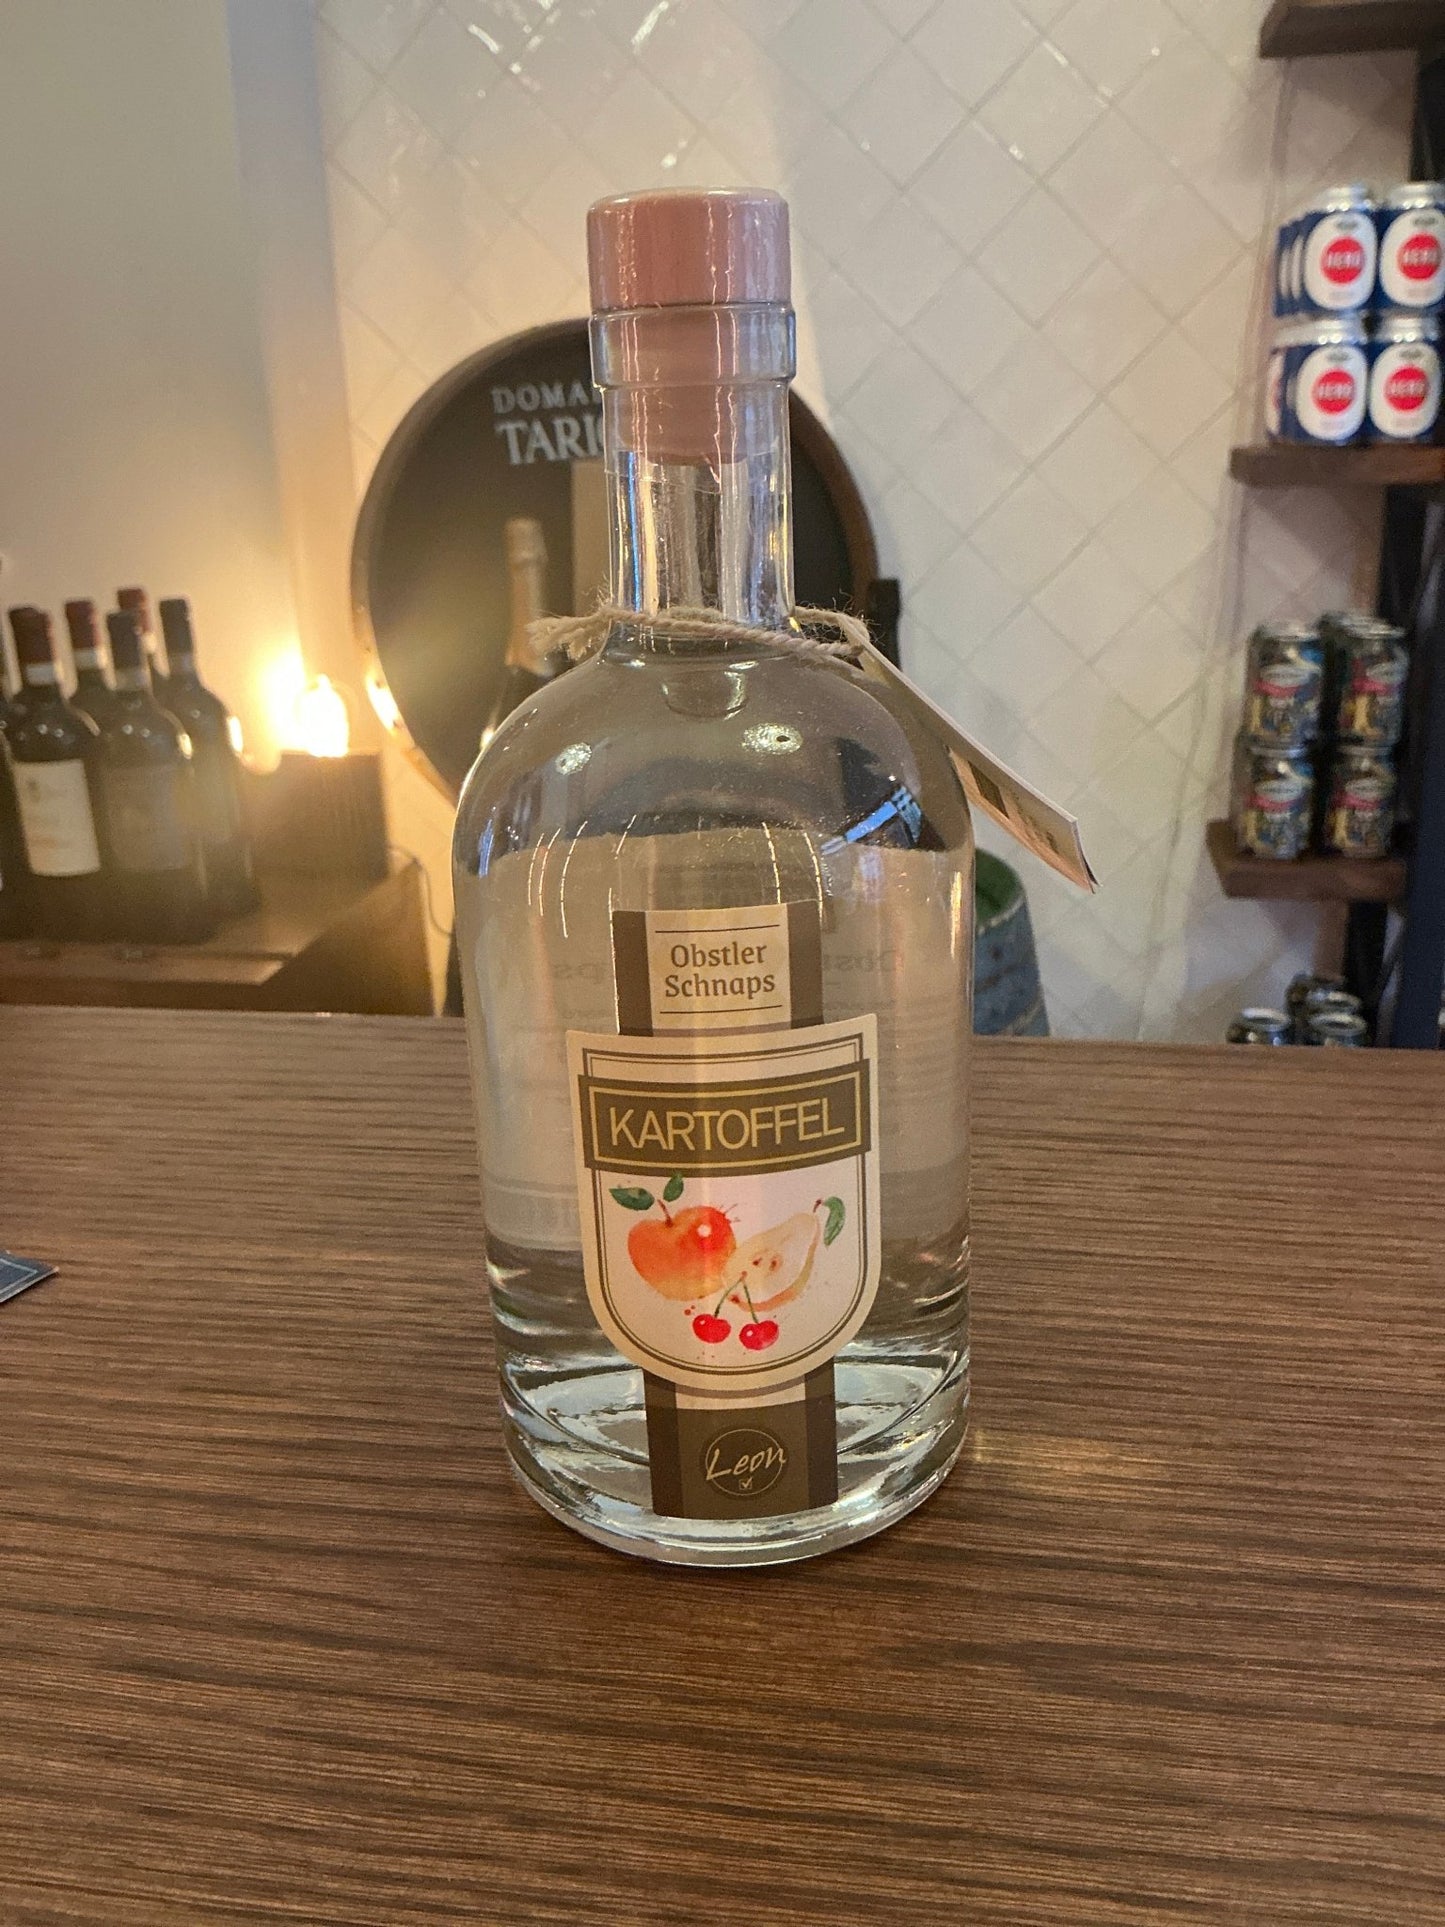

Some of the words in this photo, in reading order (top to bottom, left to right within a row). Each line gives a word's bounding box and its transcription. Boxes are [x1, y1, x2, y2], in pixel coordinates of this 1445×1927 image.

[670, 941, 767, 968] Obstler
[665, 974, 775, 999] Schnaps
[609, 1097, 845, 1150] KARTOFFEL
[706, 1447, 787, 1481] Leon
